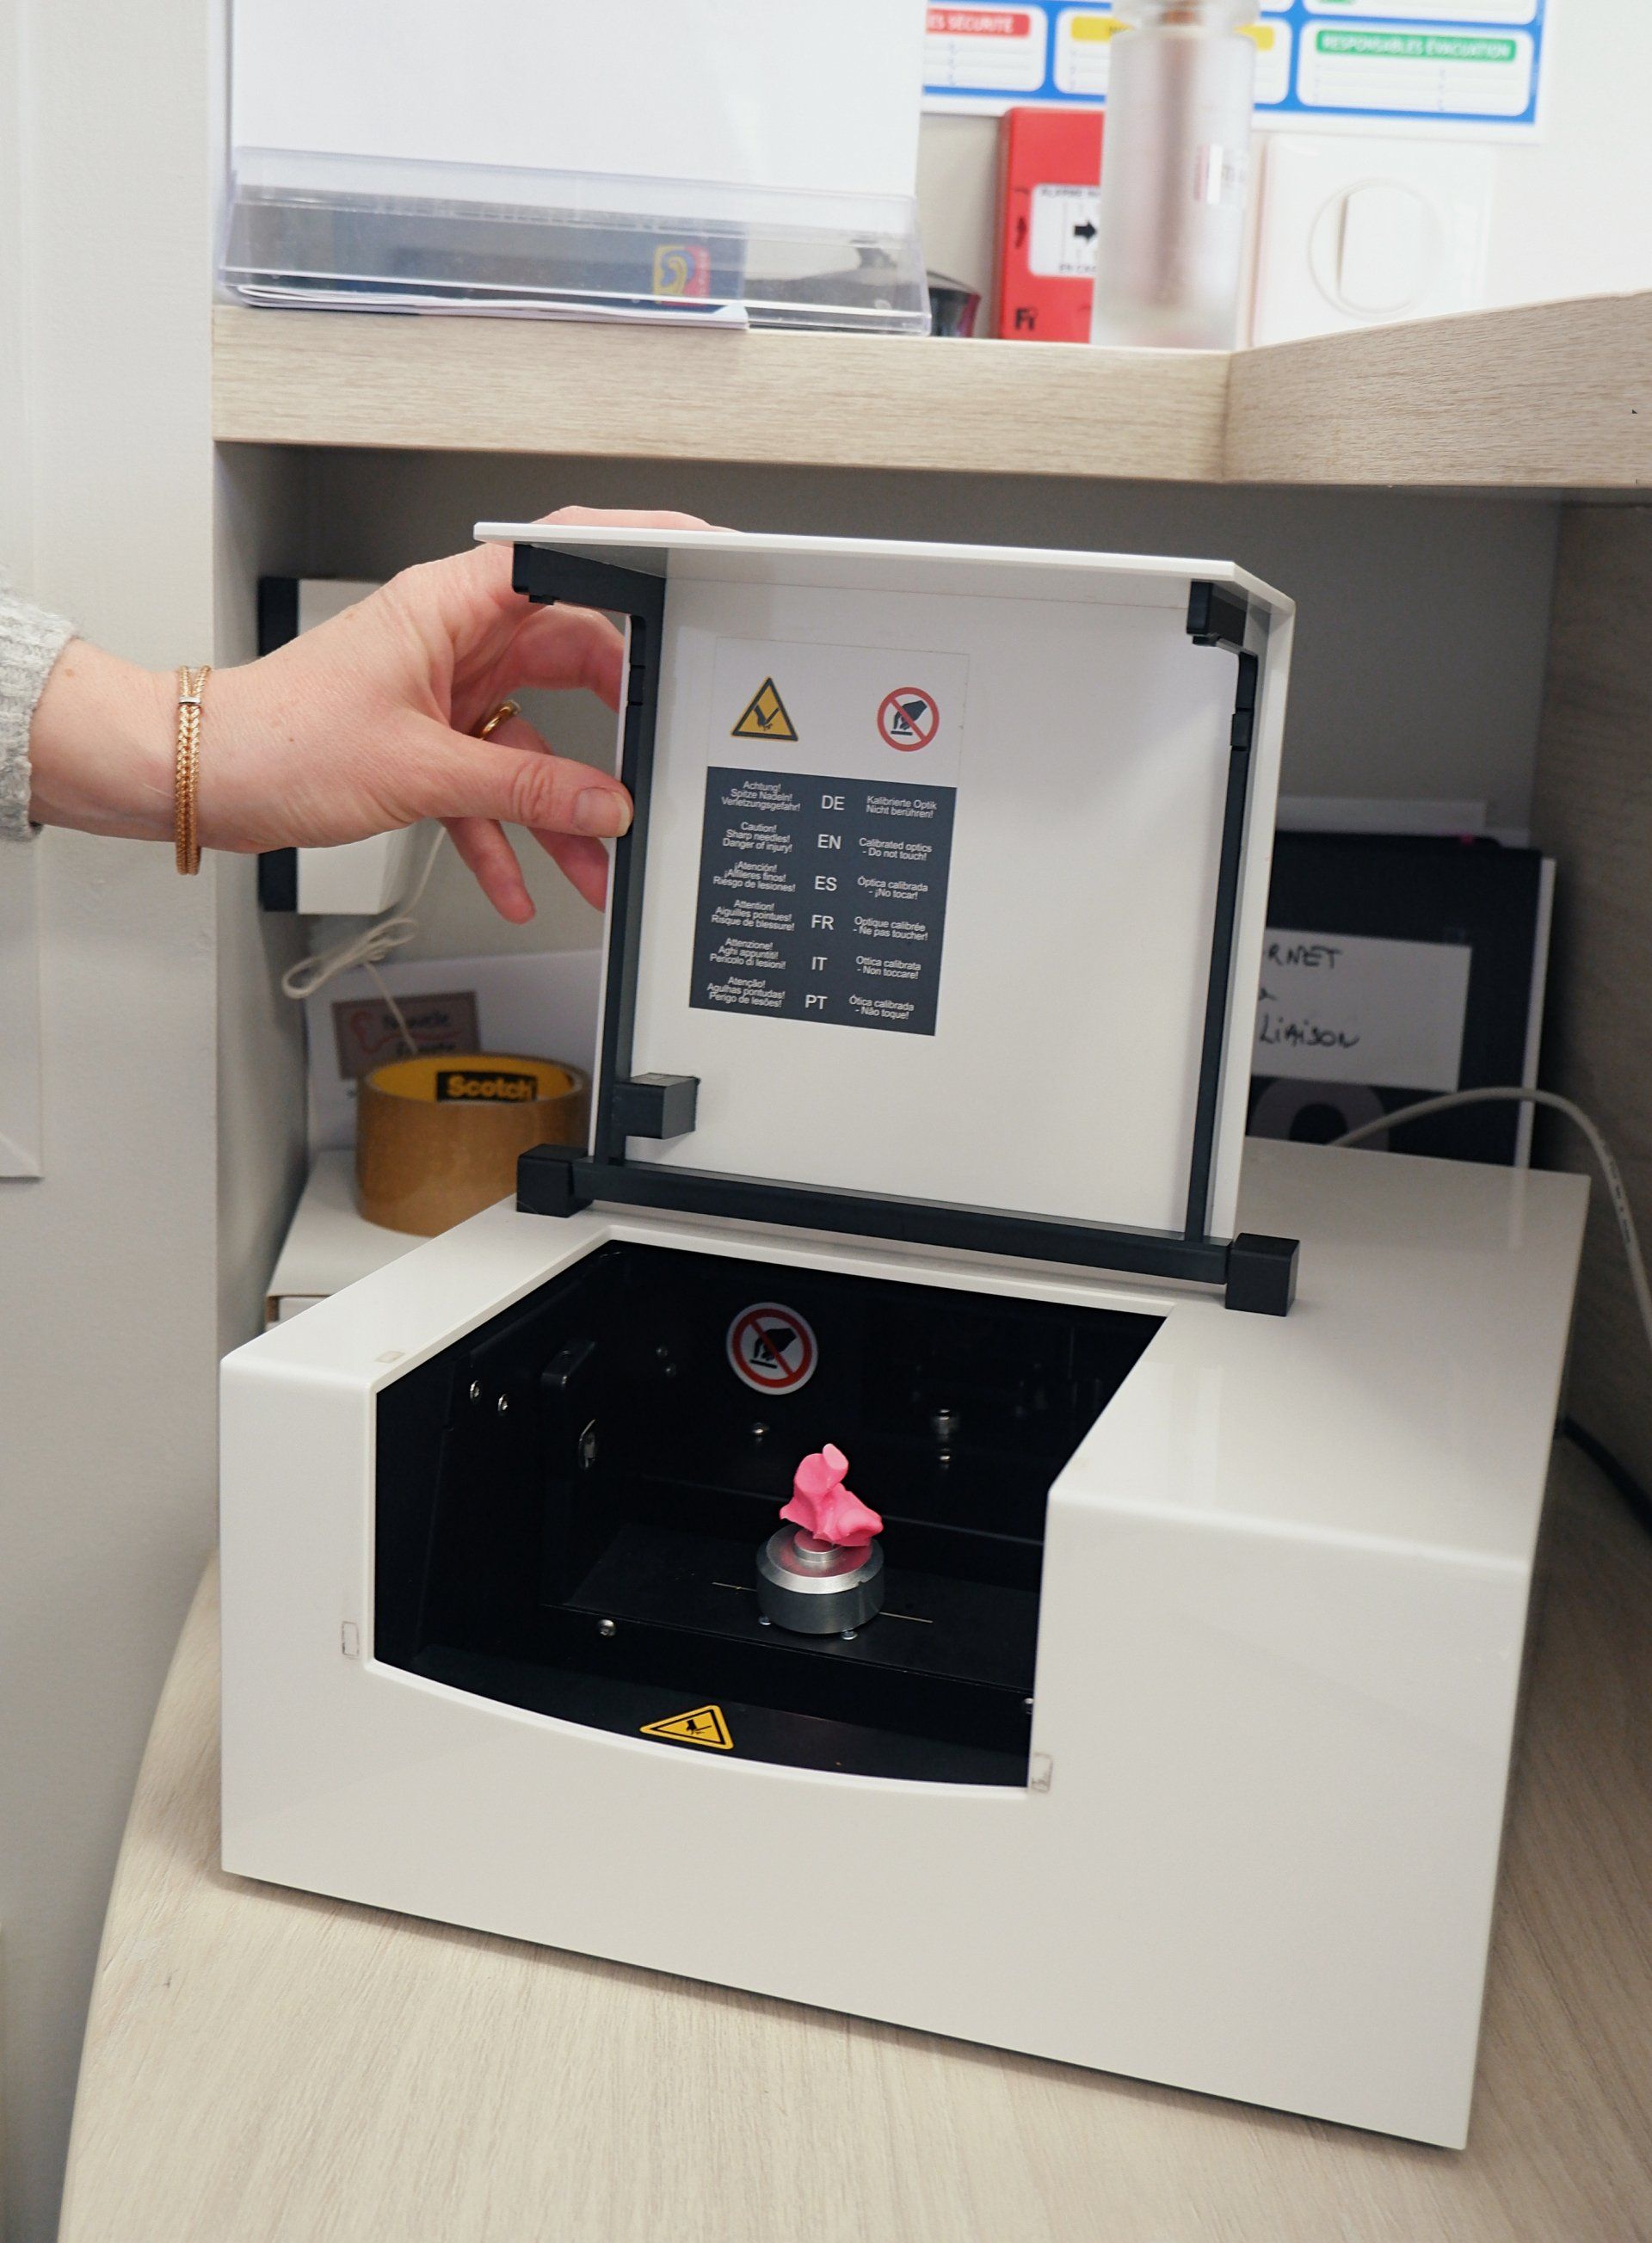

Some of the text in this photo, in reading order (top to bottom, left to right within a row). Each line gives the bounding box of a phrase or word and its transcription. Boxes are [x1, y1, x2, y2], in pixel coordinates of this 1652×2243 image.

[1322, 34, 1423, 55] RESPONSABLES
[743, 780, 781, 792] Achtung!
[730, 788, 792, 802] Spitze Nadeln!
[821, 795, 845, 810] DE
[866, 796, 937, 810] Kalibrierte Optik
[866, 804, 891, 815] Nicht
[741, 822, 777, 833] Caution!
[726, 829, 791, 843] Sharp needles!
[817, 834, 841, 849] EN
[723, 838, 755, 850] Danger
[766, 842, 792, 853] injury!
[859, 837, 933, 853] Calibrated optics
[868, 847, 882, 857] Do
[884, 850, 897, 859] not
[899, 851, 927, 861] touch!
[712, 876, 743, 888] Riesgo
[757, 881, 796, 892] lesiones!
[814, 876, 838, 891] ES
[888, 881, 928, 892] calibrada
[893, 890, 918, 900] tocar!
[733, 899, 774, 911] Attention!
[715, 906, 792, 922] Aiguilles pointues!
[711, 914, 795, 931] Risque de blessure!
[811, 915, 835, 930] FR
[854, 916, 926, 932] Optique calibrée
[859, 927, 872, 935] Ne
[873, 929, 891, 938] pas
[891, 929, 928, 941] toucher!
[724, 937, 774, 950] Attenzione!
[710, 952, 744, 965] Pericolo
[745, 958, 755, 966] di
[1267, 943, 1342, 968] RNET
[811, 956, 829, 971] IT
[855, 956, 922, 971] Ottica calibrata
[863, 965, 882, 976] Non
[883, 968, 919, 980] toccare!
[709, 991, 737, 1004] Perigo
[738, 995, 750, 1004] de
[743, 988, 786, 999] pontudas!
[804, 995, 829, 1010] PT
[874, 999, 914, 1011] calibrada
[881, 1009, 909, 1020] toque!
[448, 1075, 532, 1100] Scotch
